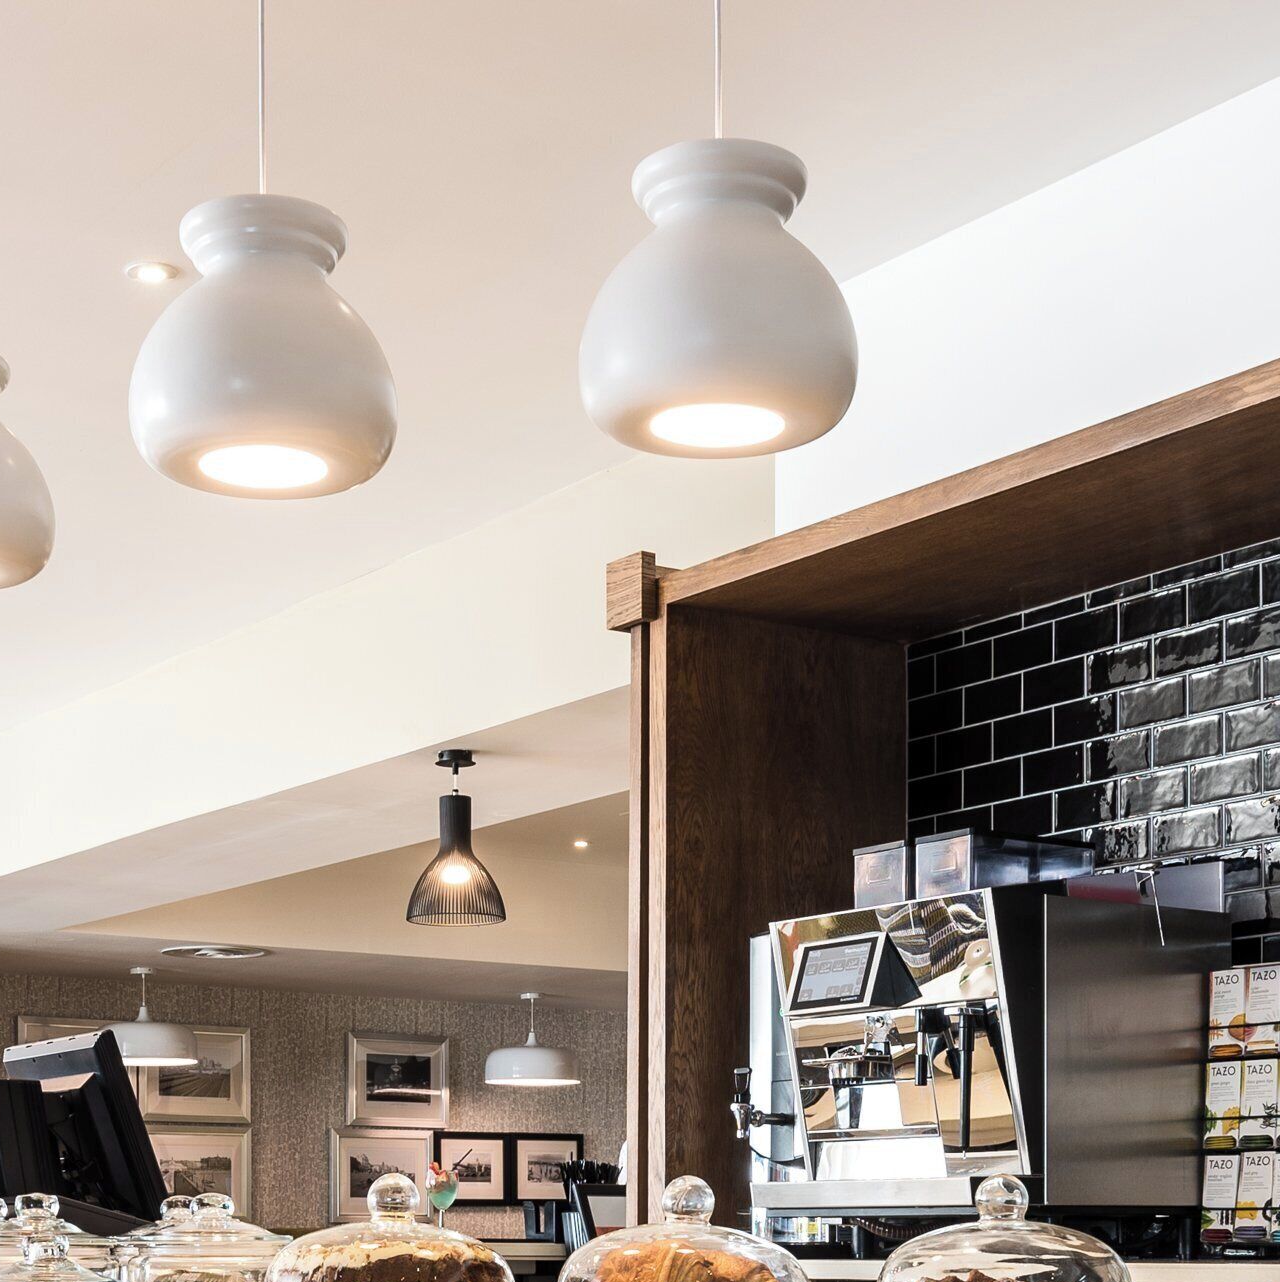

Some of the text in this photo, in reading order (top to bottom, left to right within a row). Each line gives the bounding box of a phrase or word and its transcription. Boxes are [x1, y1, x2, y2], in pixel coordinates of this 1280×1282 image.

[1214, 974, 1240, 986] TAZO
[1251, 969, 1277, 982] TAZO
[1211, 1065, 1236, 1077] TAZO
[1246, 1064, 1273, 1075] TAZO
[1209, 1159, 1233, 1170] TAZO
[1245, 1155, 1271, 1166] TAZO
